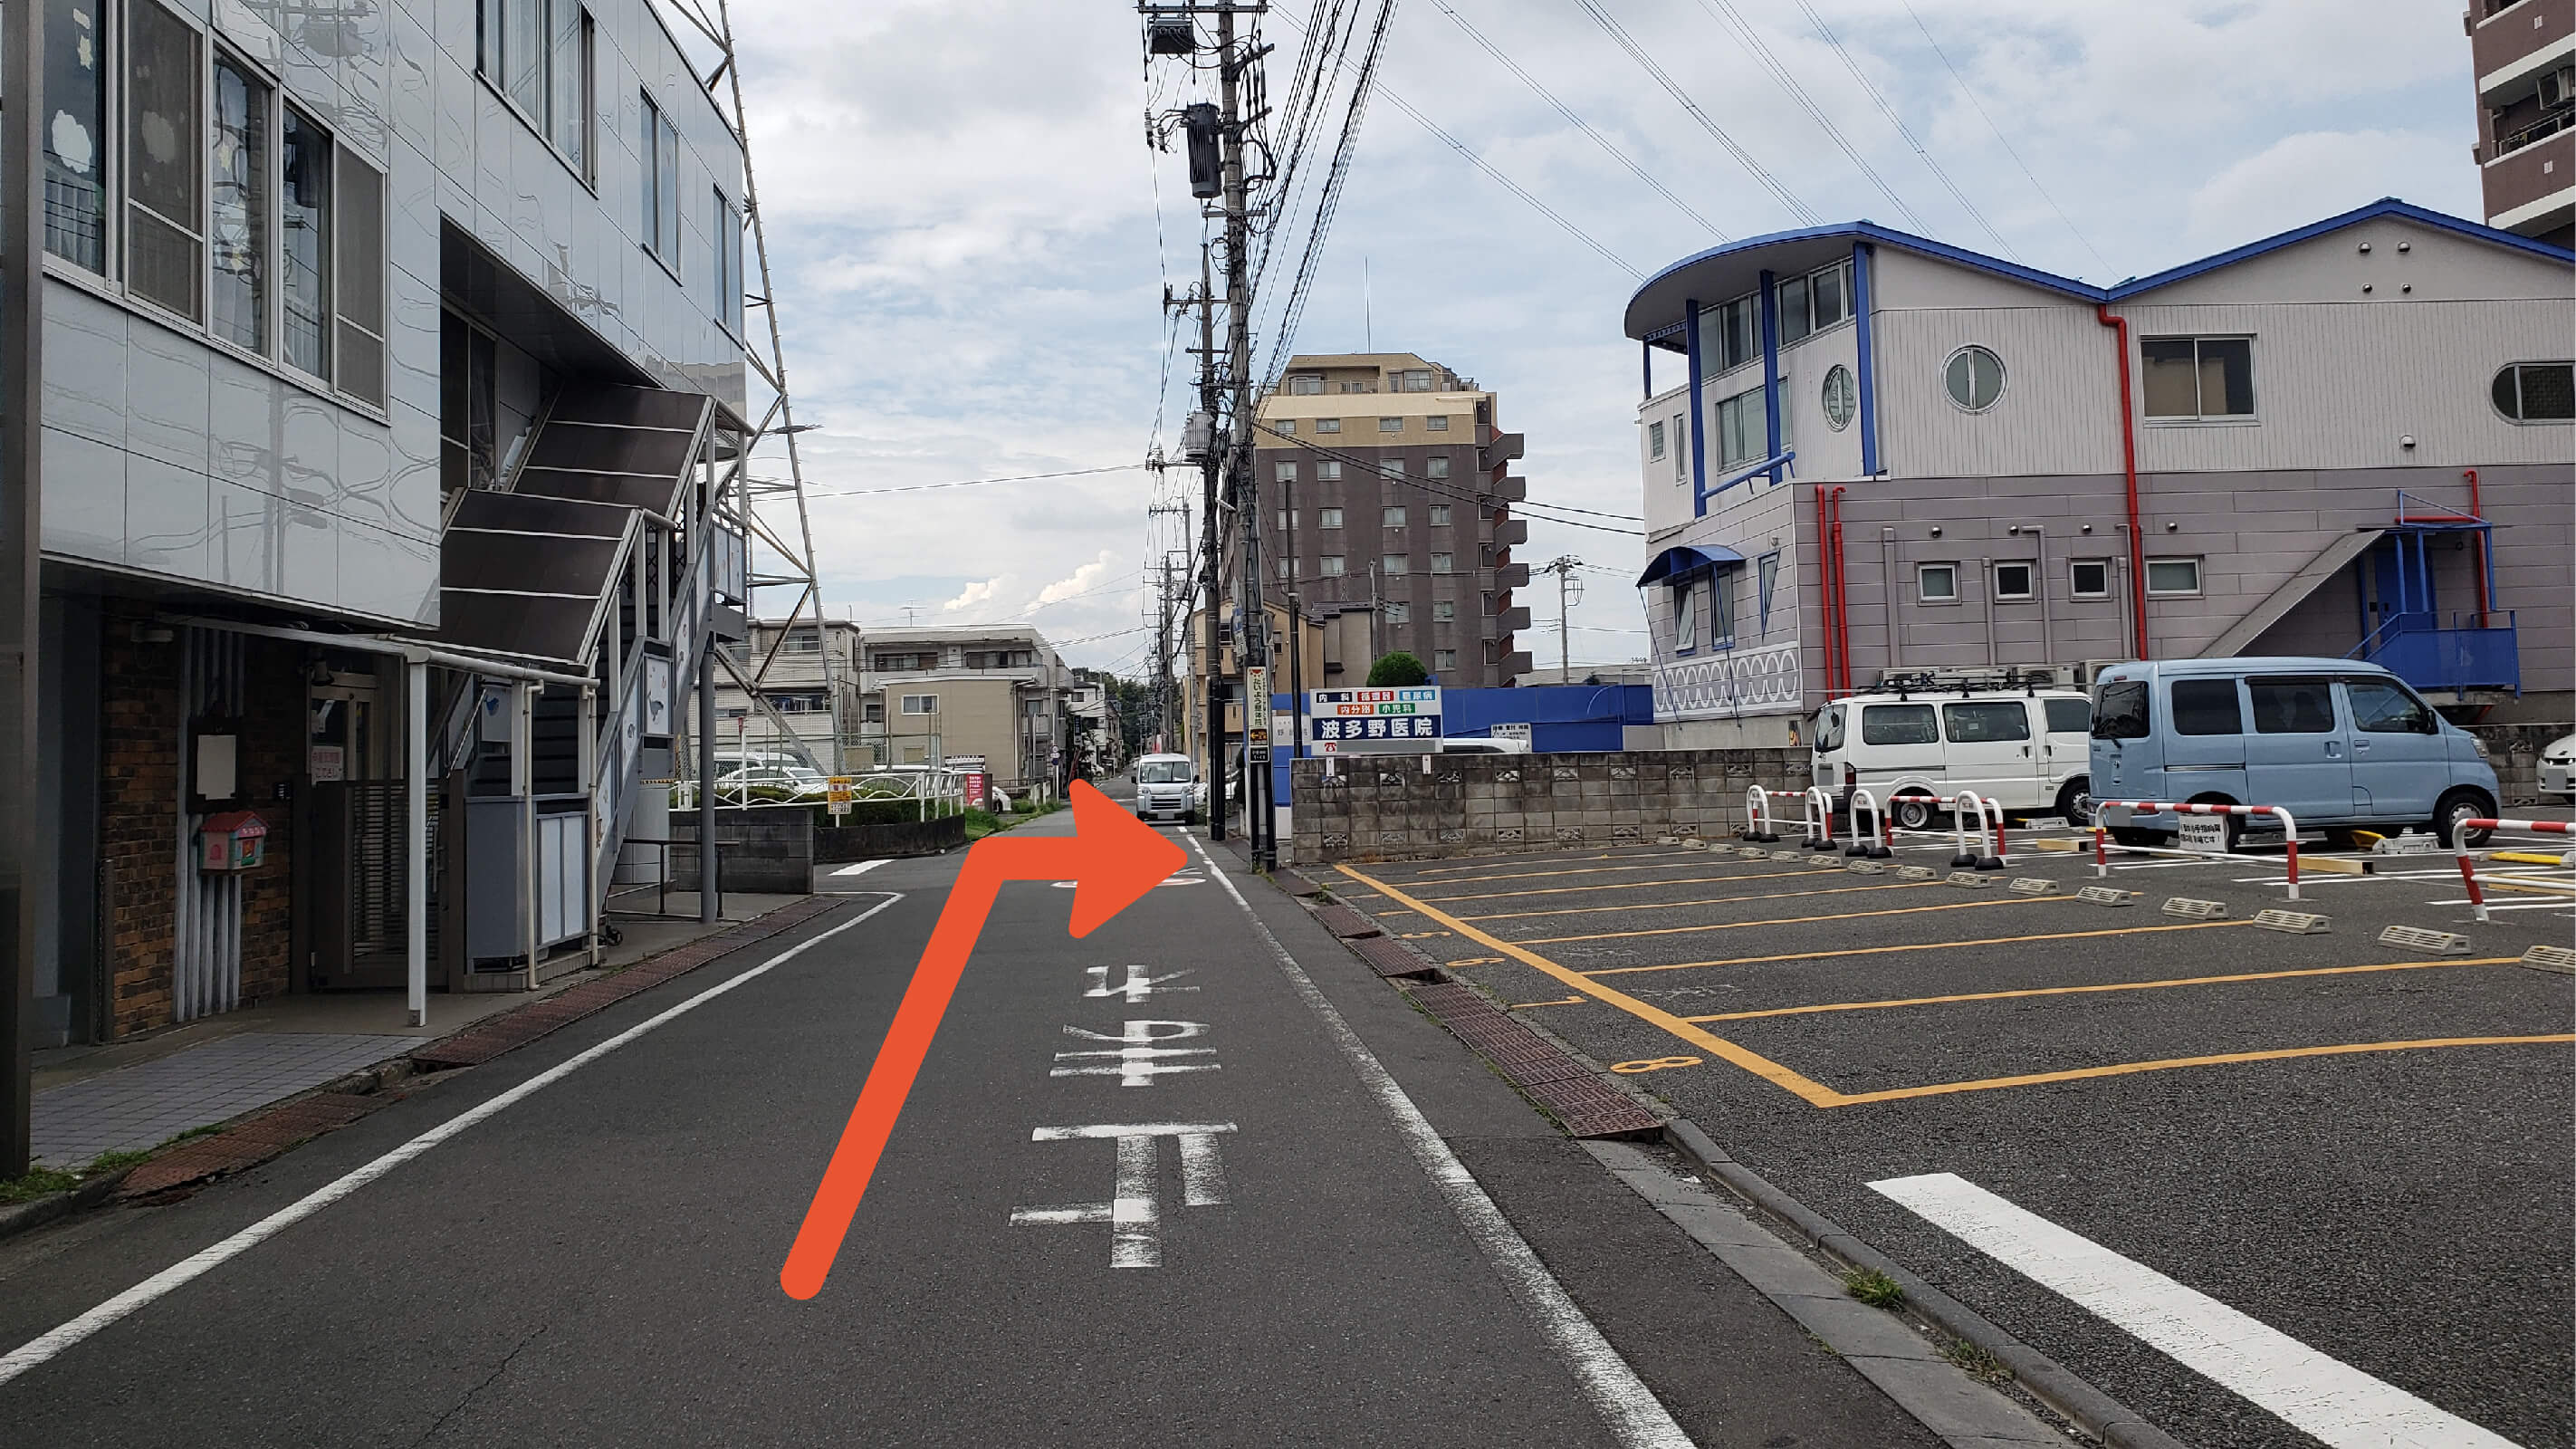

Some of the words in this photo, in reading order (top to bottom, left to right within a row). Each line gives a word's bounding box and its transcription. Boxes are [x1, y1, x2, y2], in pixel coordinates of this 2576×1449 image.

[1318, 693, 1350, 703] 内科
[1382, 704, 1412, 714] 小児科
[1321, 716, 1433, 739] 波多野医院
[1610, 1055, 1704, 1074] 8
[1007, 964, 1239, 1269] 止まれ
